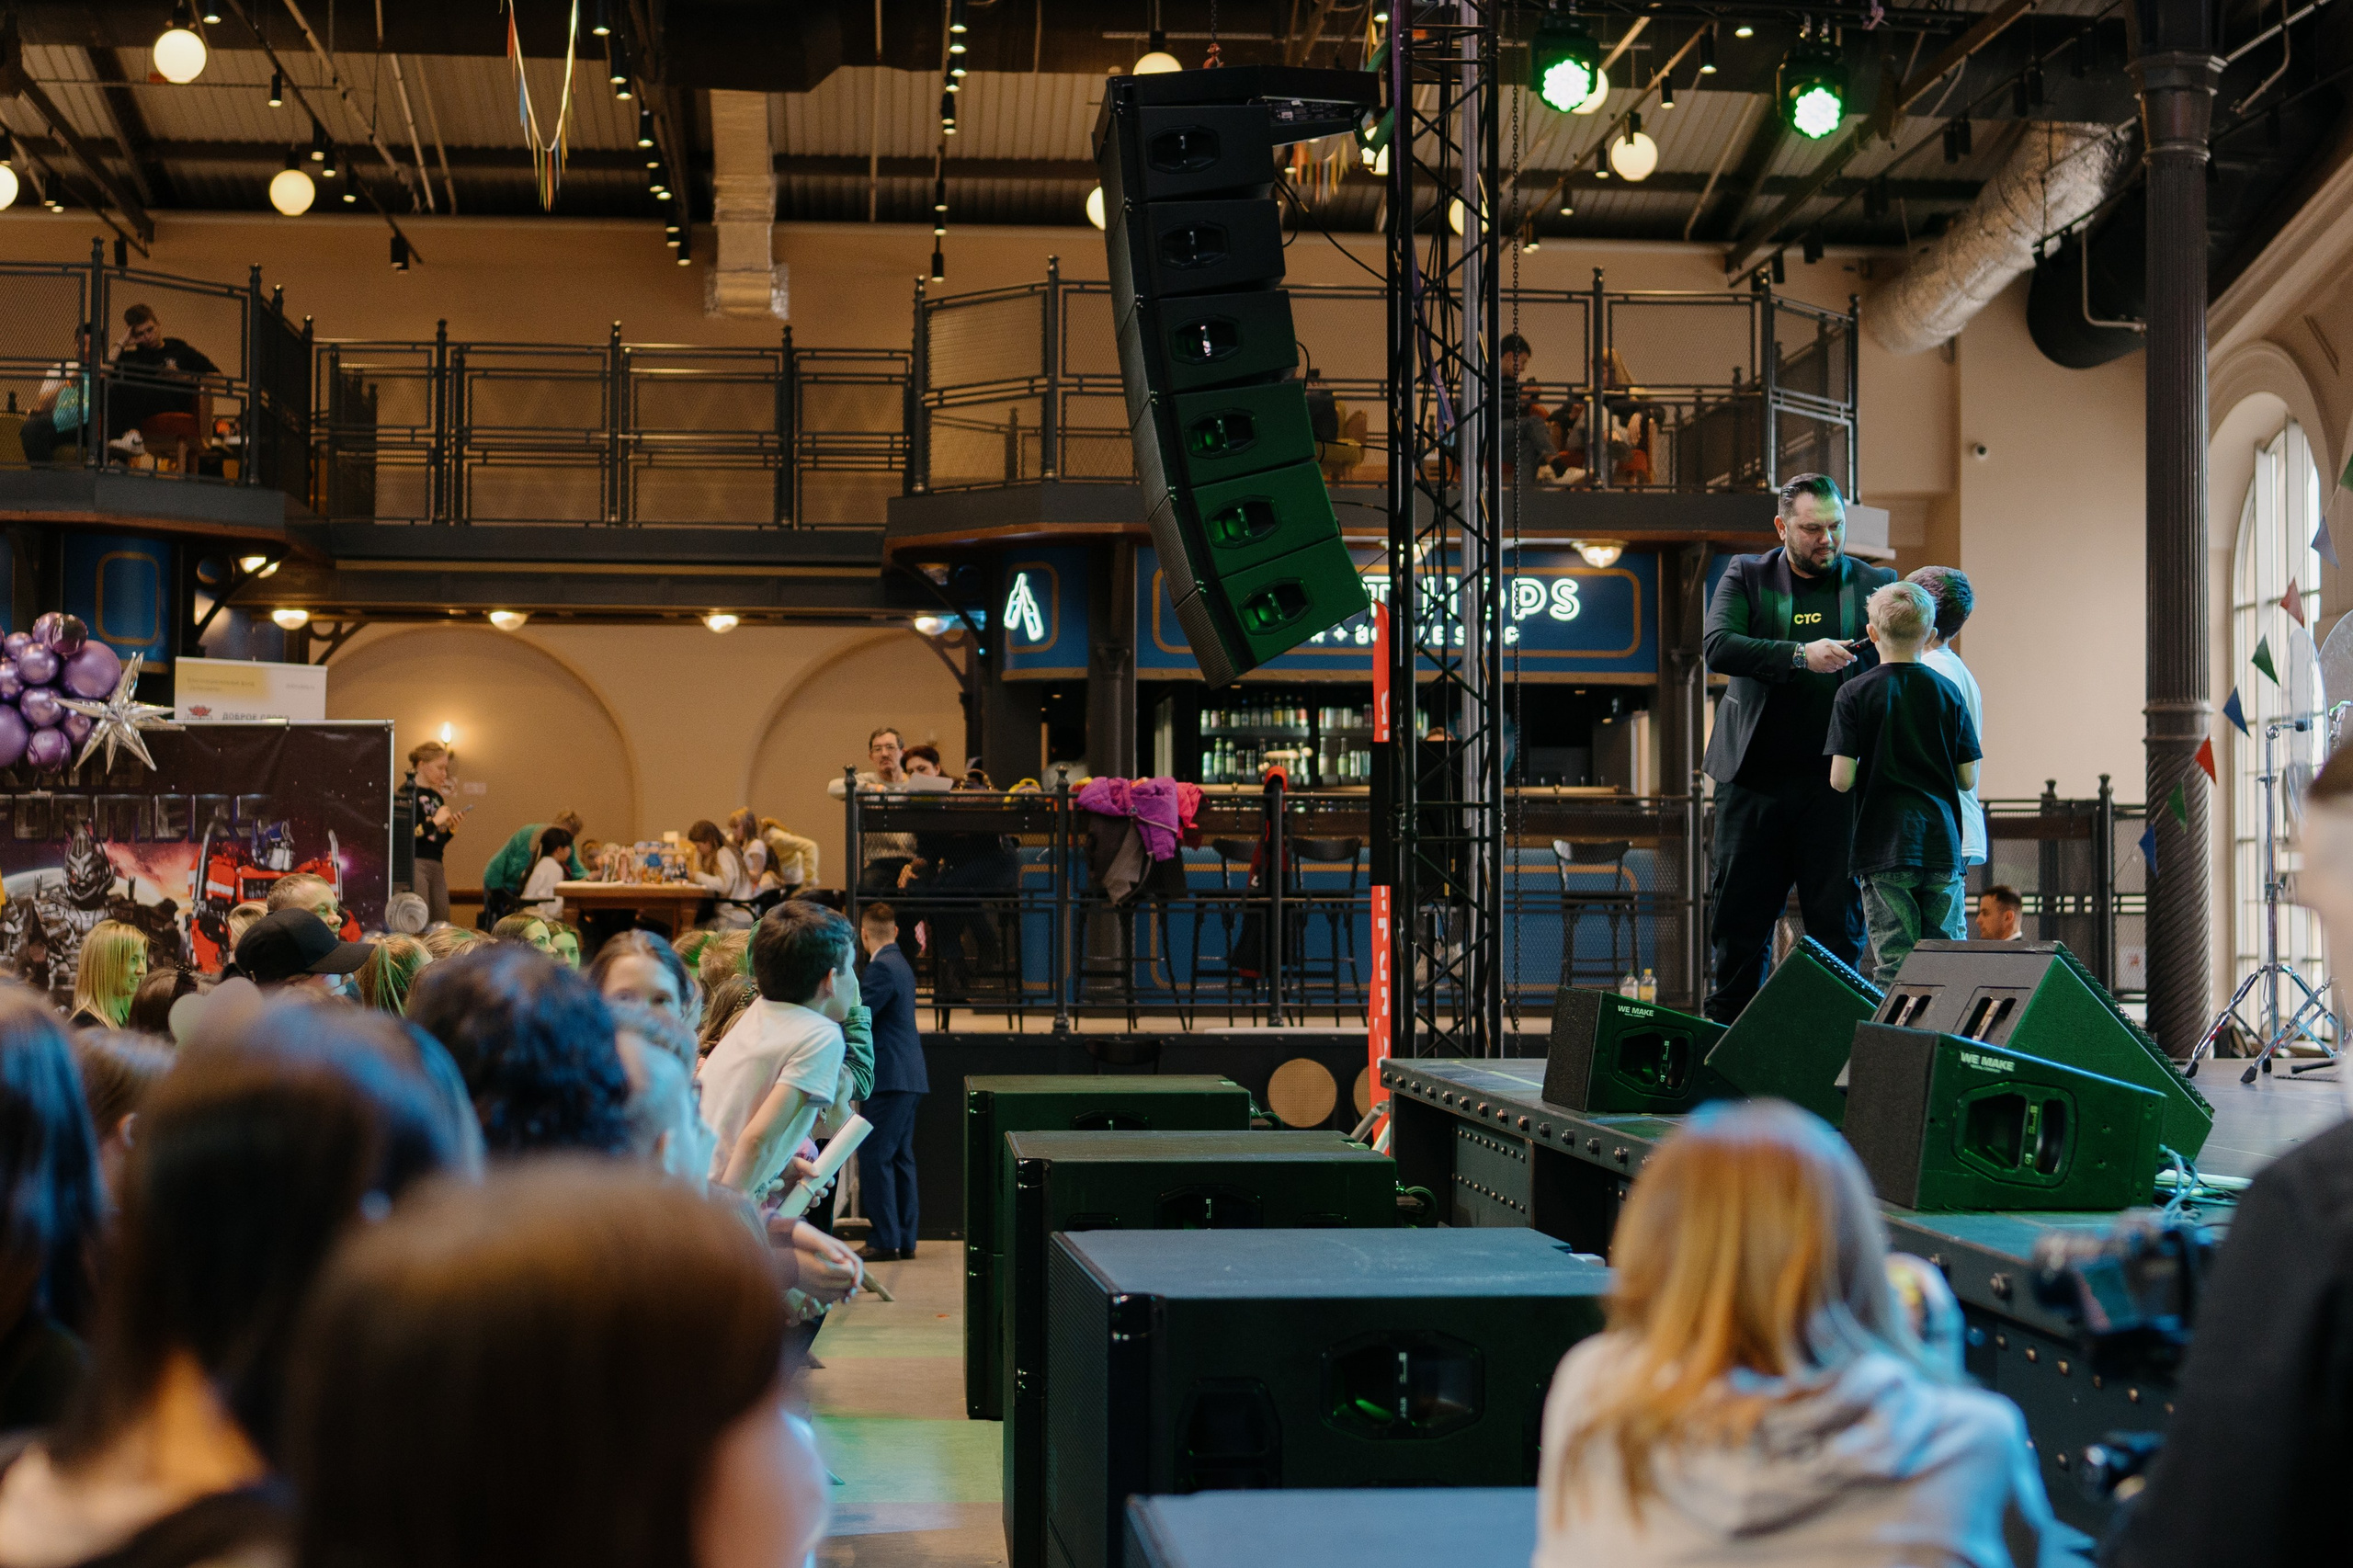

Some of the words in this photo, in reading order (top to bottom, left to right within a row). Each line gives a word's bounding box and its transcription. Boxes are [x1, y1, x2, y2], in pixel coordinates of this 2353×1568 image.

[1454, 625, 1519, 645] SP
[1618, 1005, 1631, 1013] WE
[1631, 1006, 1654, 1017] MAKE
[1961, 1051, 1980, 1064] WE
[1981, 1056, 2016, 1072] MAKE
